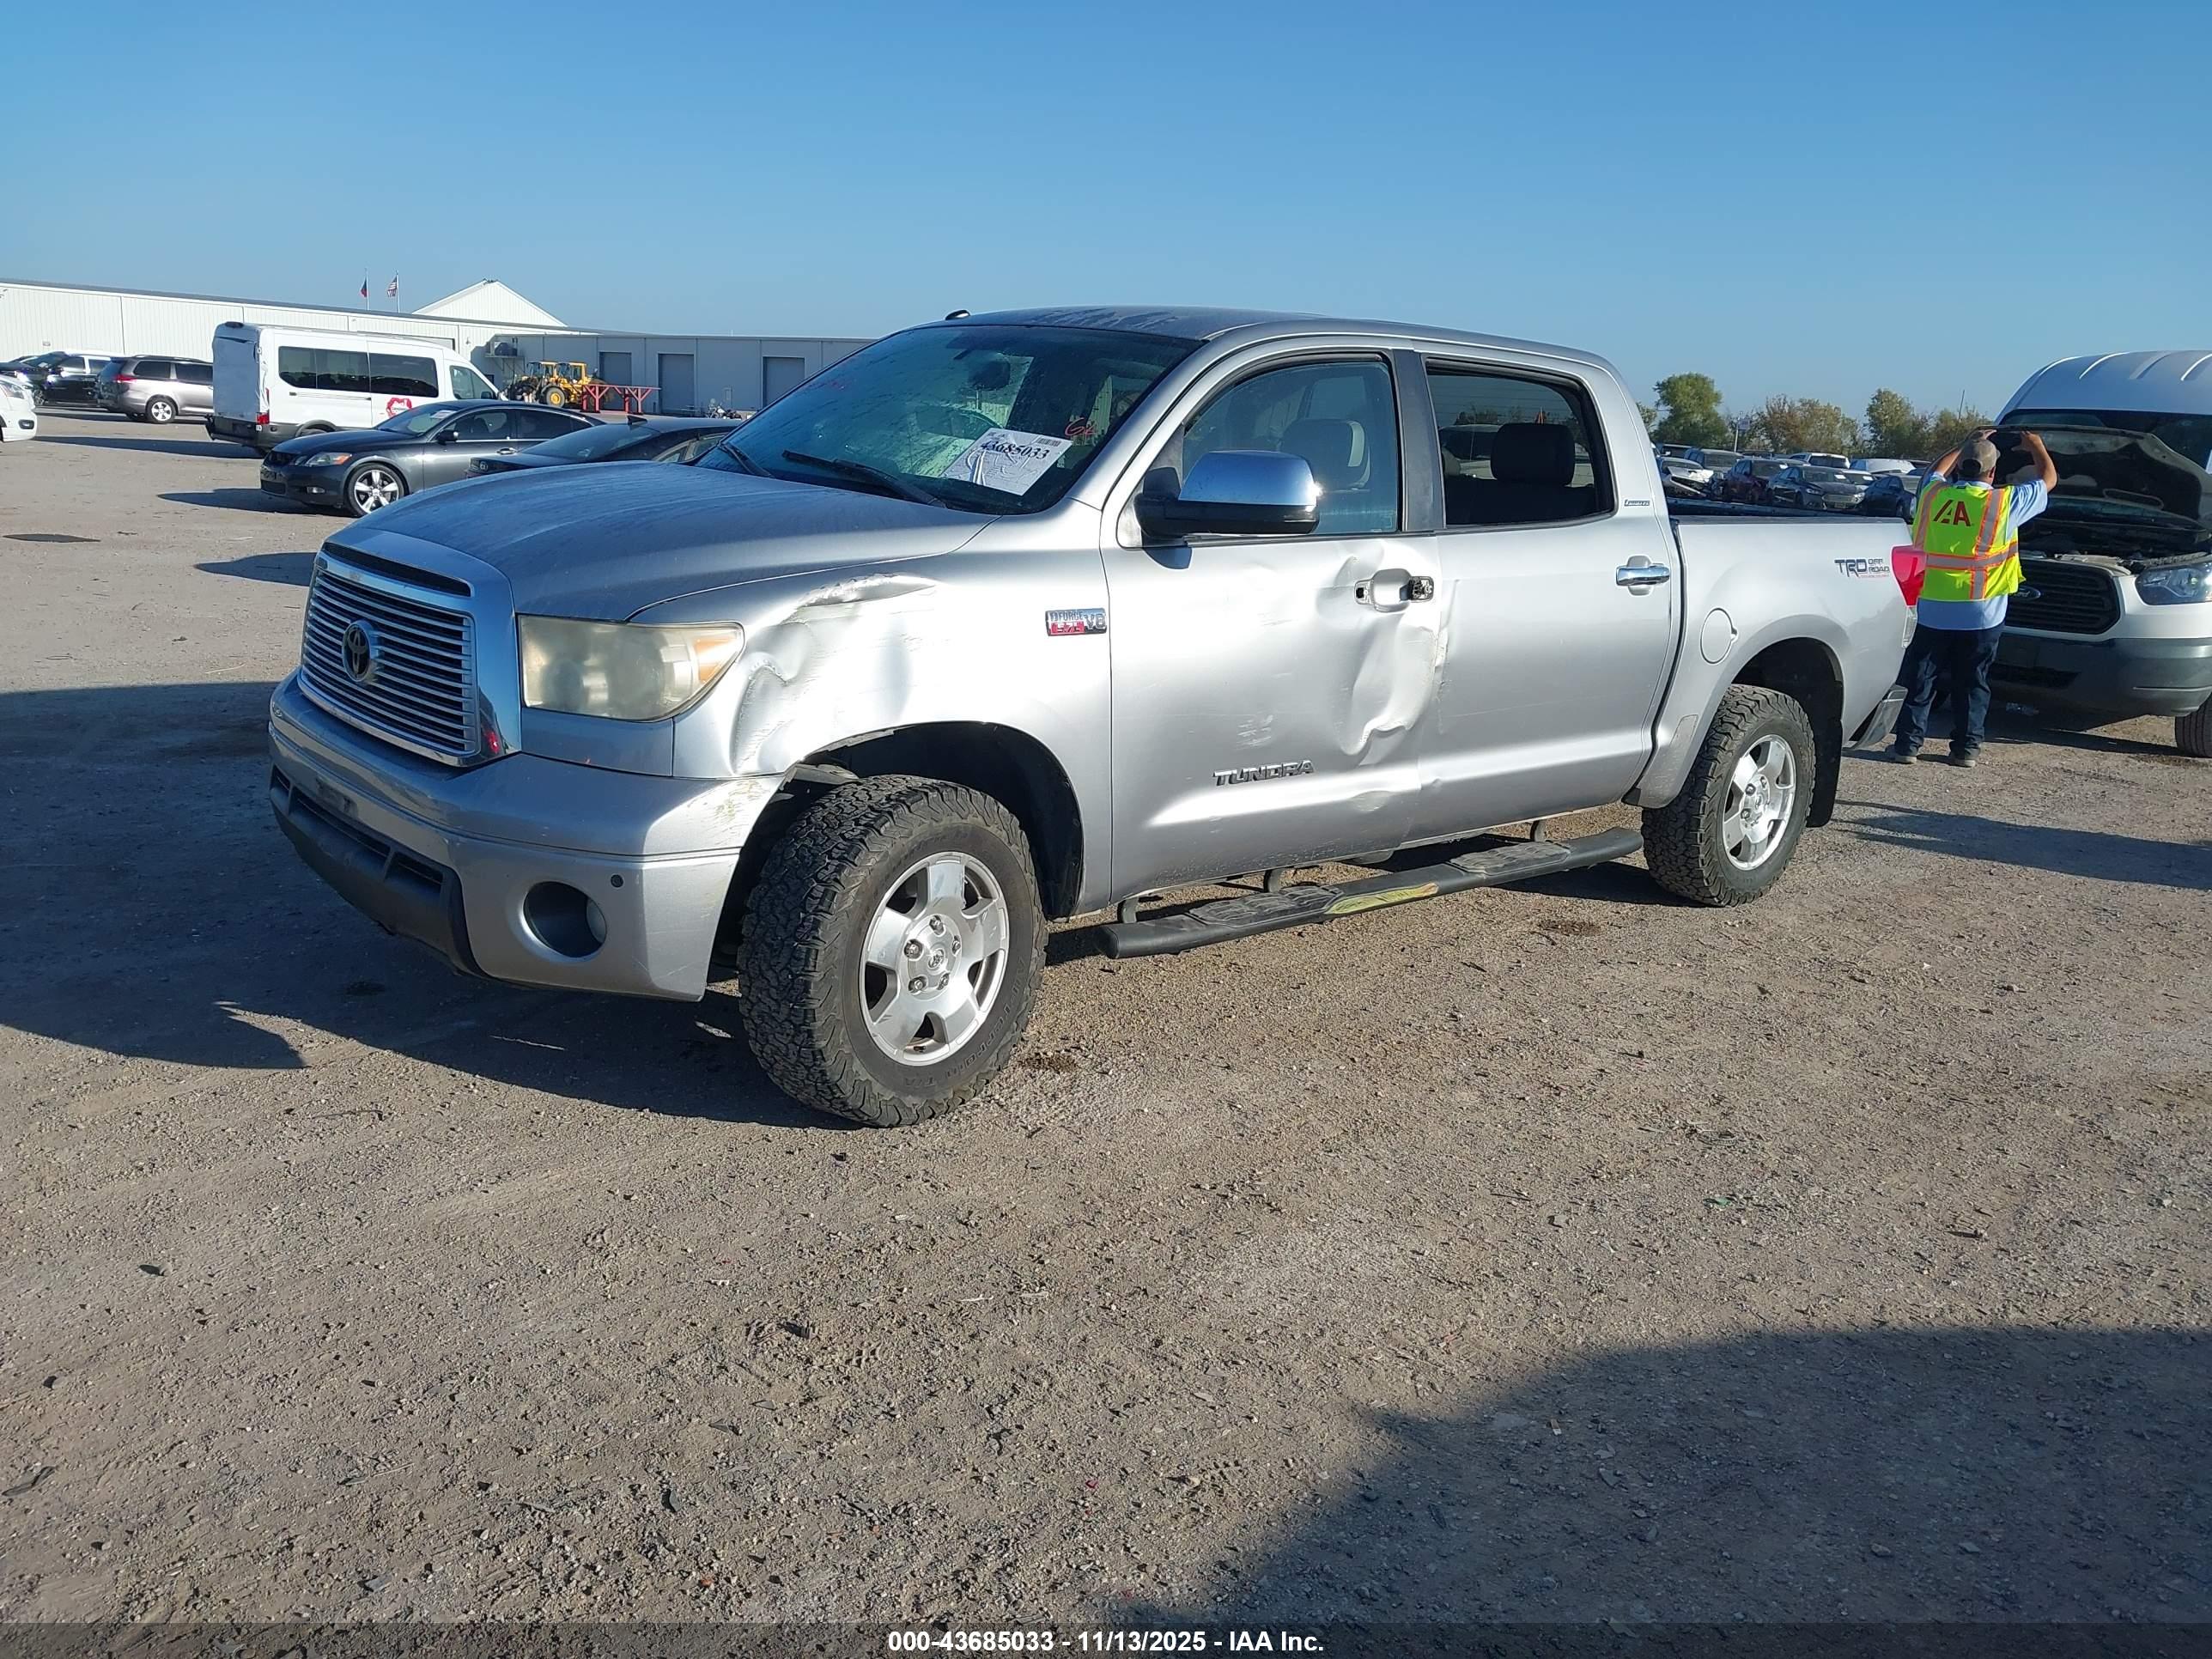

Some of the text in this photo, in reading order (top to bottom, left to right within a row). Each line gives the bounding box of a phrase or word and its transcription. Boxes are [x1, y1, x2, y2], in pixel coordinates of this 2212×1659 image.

[980, 441, 1050, 460] 43685033
[1834, 558, 1868, 578] TRD
[1212, 759, 1314, 787] TUNDRA
